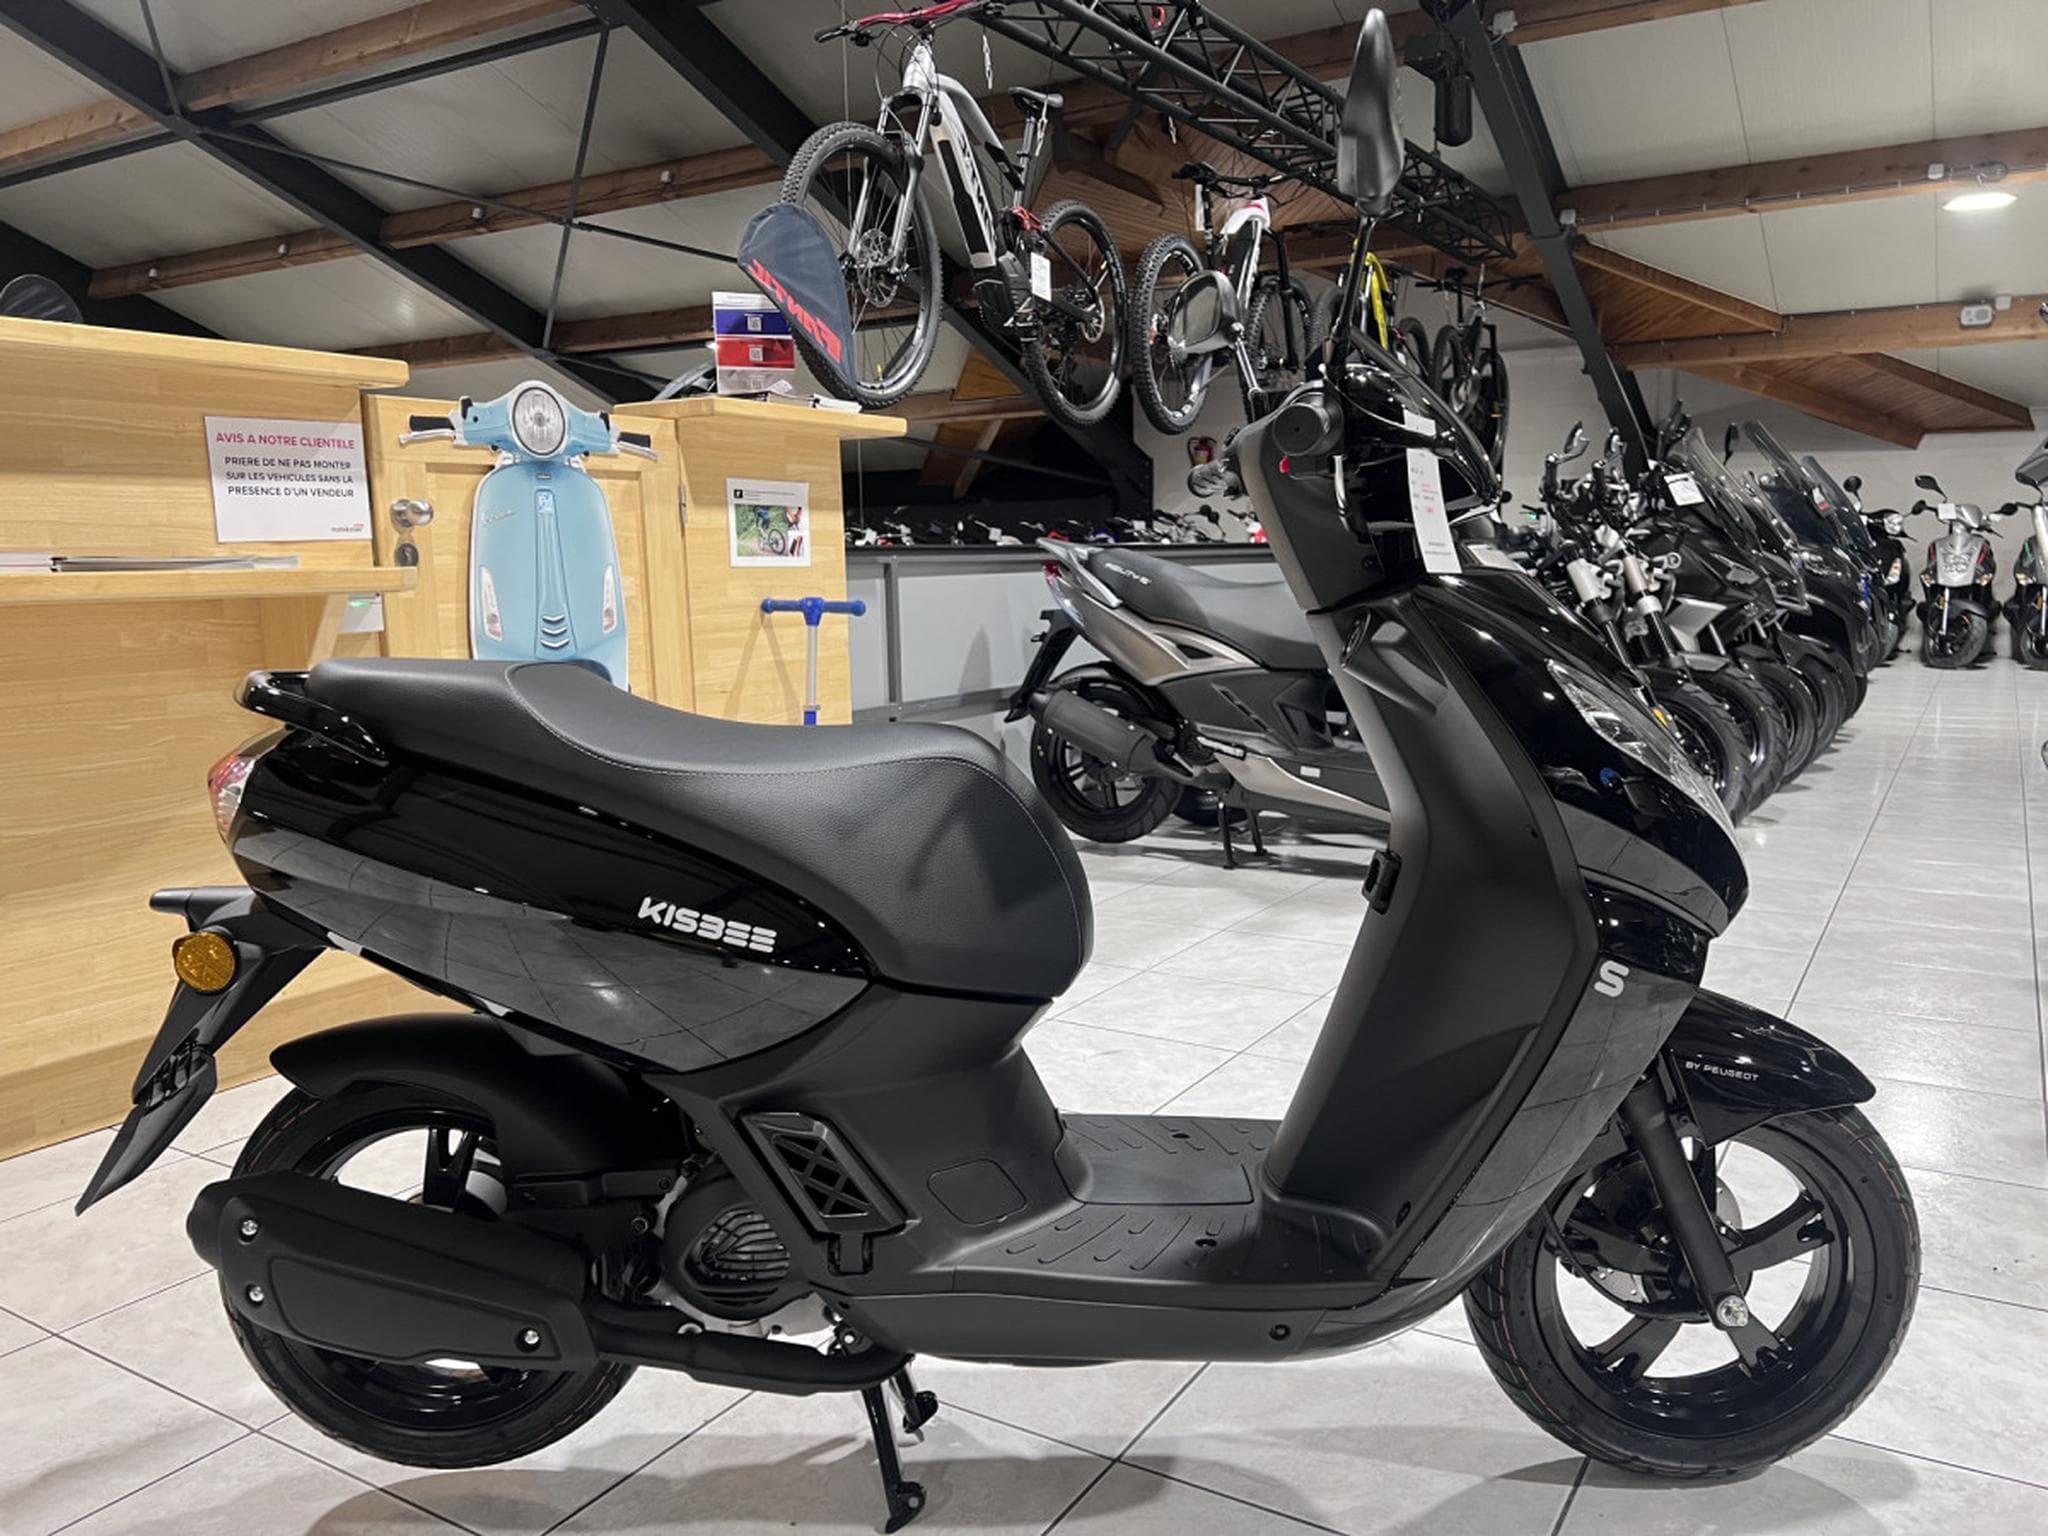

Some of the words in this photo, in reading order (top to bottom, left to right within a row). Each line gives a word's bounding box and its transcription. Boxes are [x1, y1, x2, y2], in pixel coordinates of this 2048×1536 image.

[216, 432, 244, 443] AVIS
[247, 434, 256, 444] A
[258, 434, 297, 446] NOTRE
[300, 436, 355, 450] CLIENTELE
[224, 456, 260, 467] PRIERE
[262, 457, 275, 467] DE
[278, 458, 290, 468] NE
[293, 458, 311, 469] PAS
[313, 459, 351, 470] MONTER
[225, 471, 246, 480] SUR
[247, 471, 265, 481] LES
[266, 472, 317, 482] VEHICULES
[317, 474, 341, 483] SANS
[342, 475, 354, 484] LA
[227, 485, 281, 496] PRESENCE
[284, 487, 308, 497] D'UN
[310, 487, 354, 498] VENDEUR
[637, 896, 777, 953] KISBEE
[1594, 960, 1629, 997] S
[1685, 1061, 1701, 1070] BY
[1703, 1064, 1759, 1081] PEUGEOT
